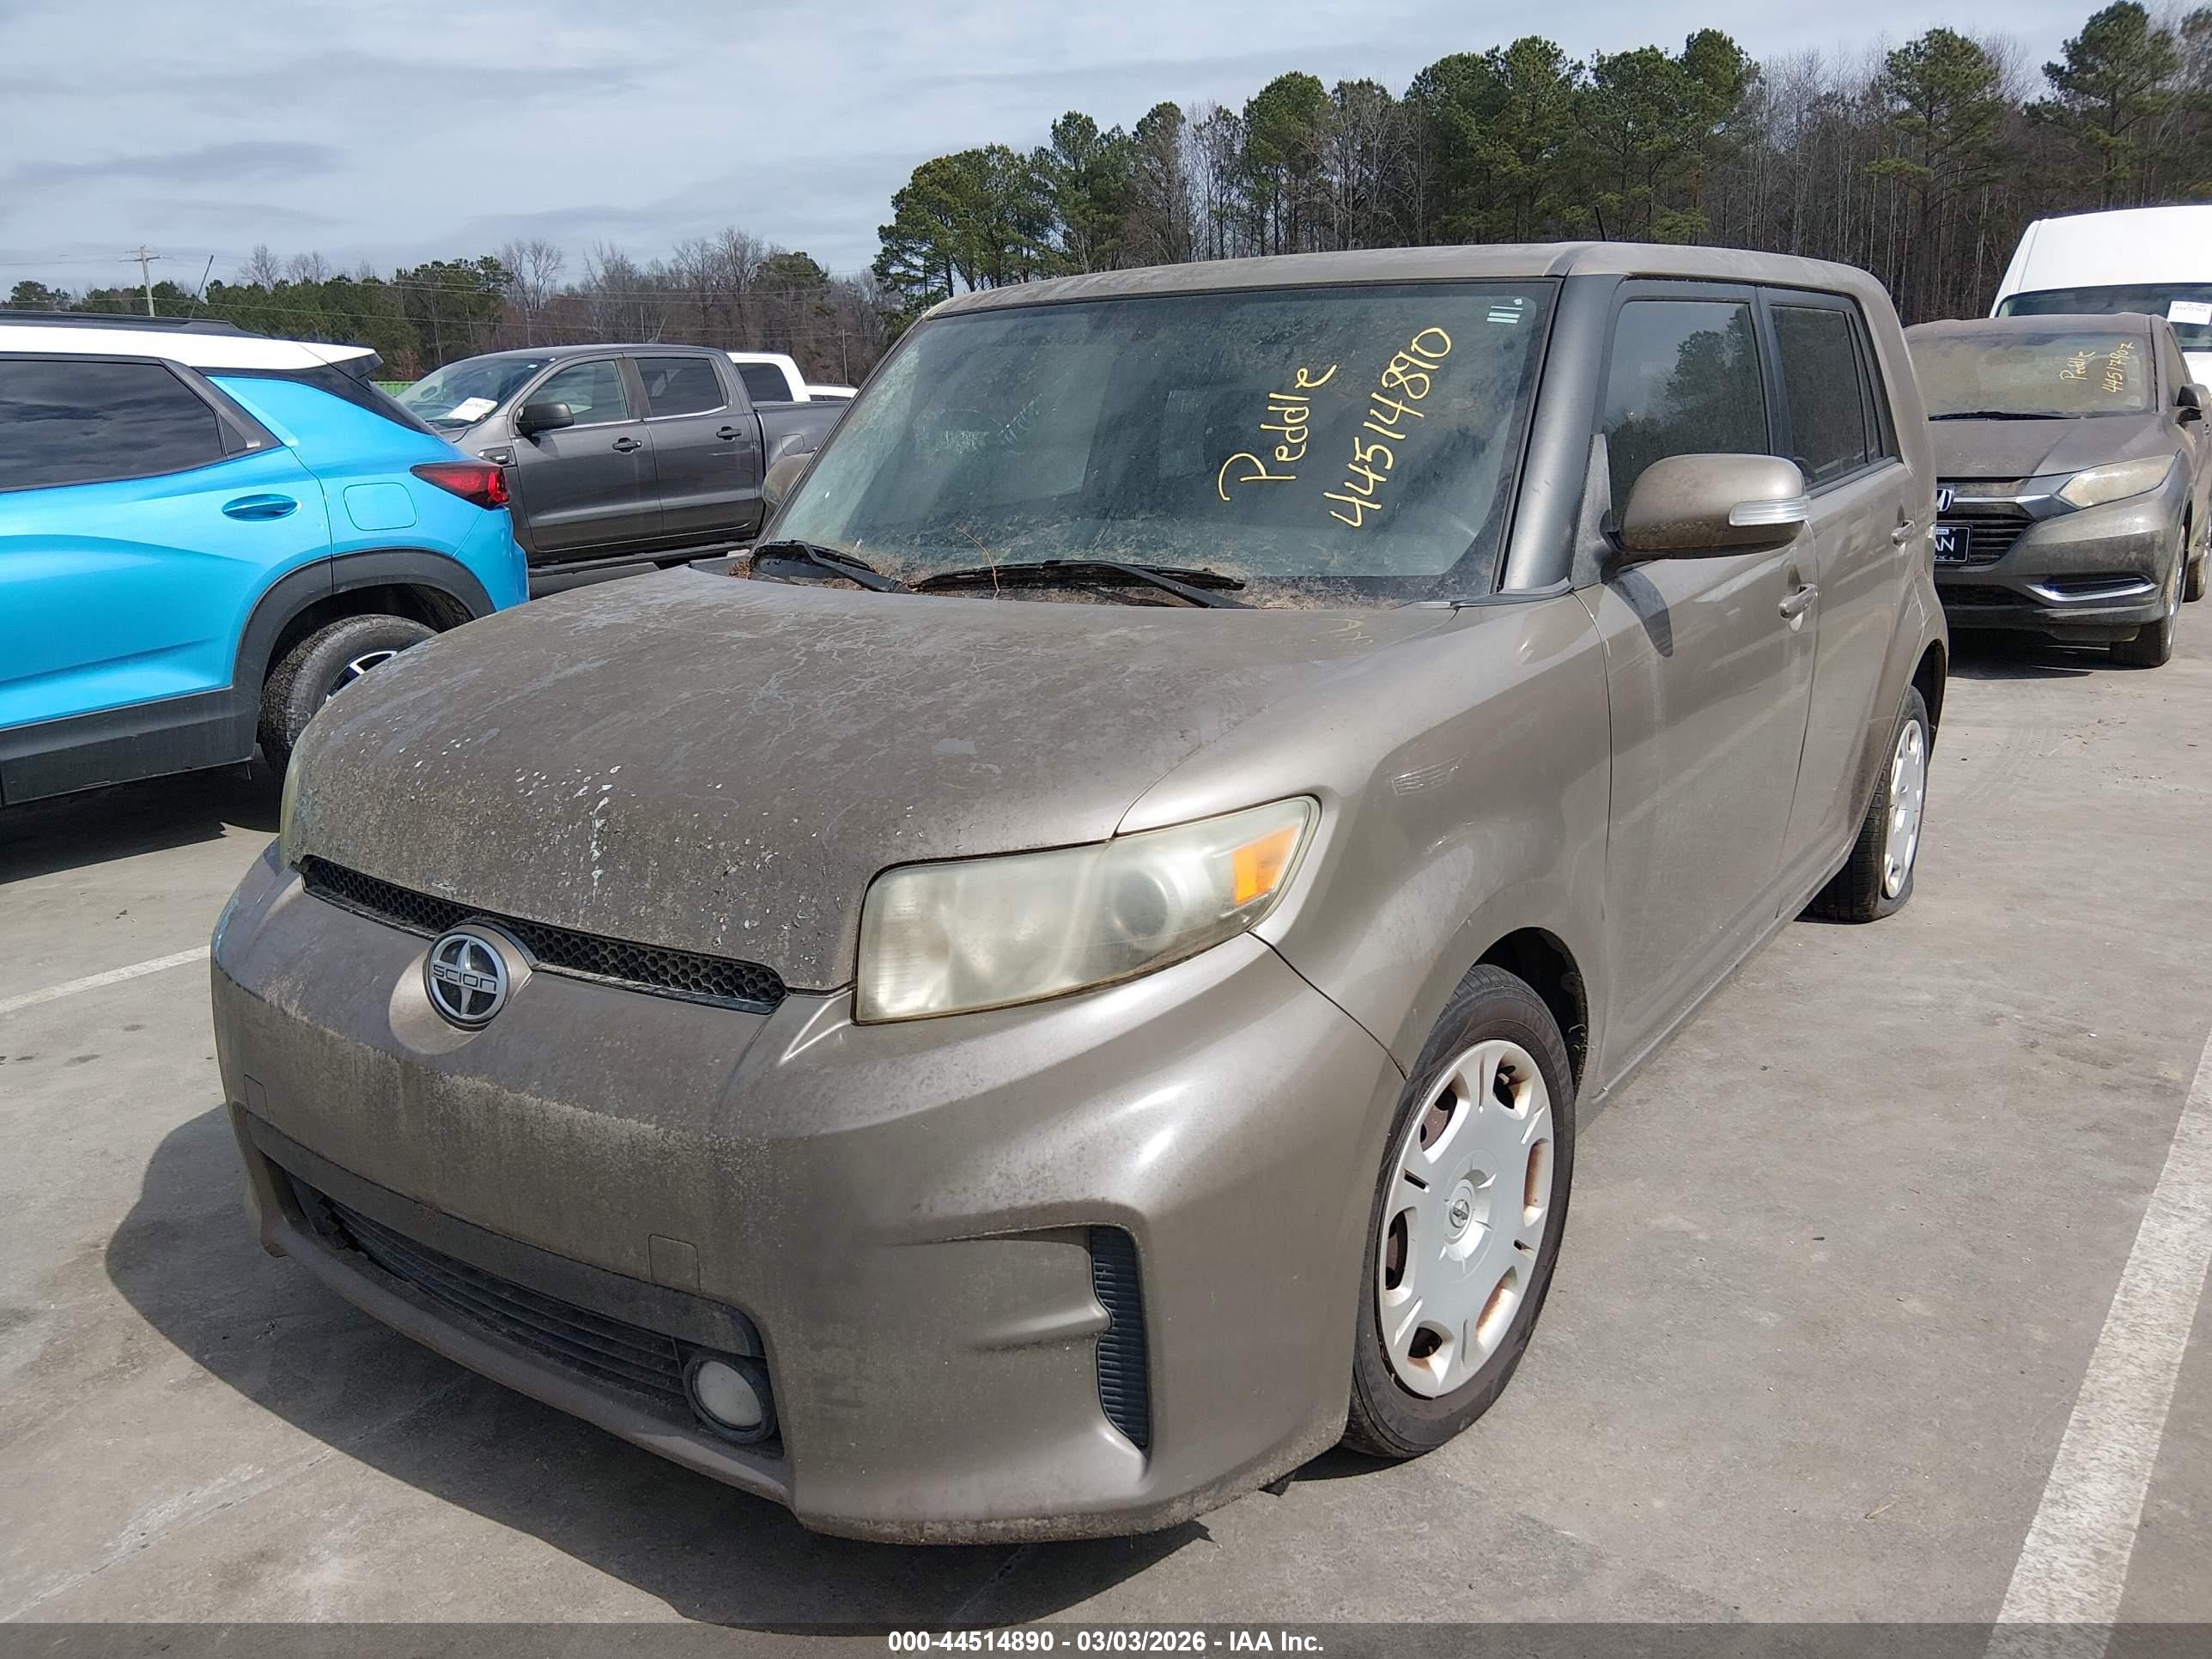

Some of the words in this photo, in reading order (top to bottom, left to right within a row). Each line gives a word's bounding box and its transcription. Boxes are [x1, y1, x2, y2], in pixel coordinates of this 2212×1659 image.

[1218, 363, 1338, 501] Peddle
[1322, 327, 1452, 527] 44514890
[433, 964, 496, 992] SCION
